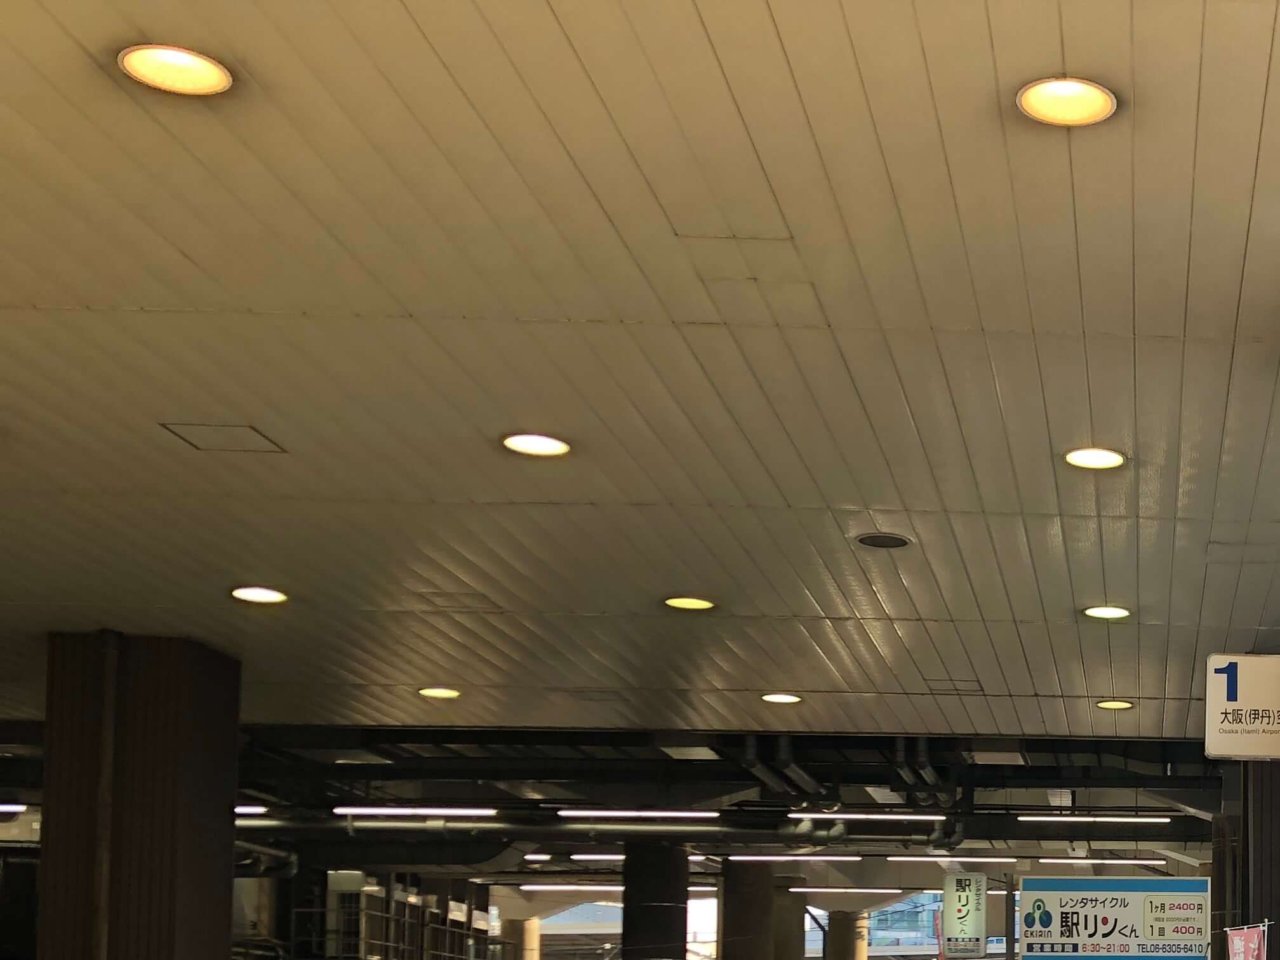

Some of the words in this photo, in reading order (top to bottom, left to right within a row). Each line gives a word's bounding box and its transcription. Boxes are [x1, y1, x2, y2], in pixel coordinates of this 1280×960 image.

[1214, 662, 1238, 702] 1
[955, 878, 972, 935] 駅リンくん
[1059, 897, 1129, 909] レンタサイクル
[1168, 903, 1203, 914] 2400円
[1060, 911, 1139, 939] 駅リンくん
[1172, 925, 1203, 936] 400円
